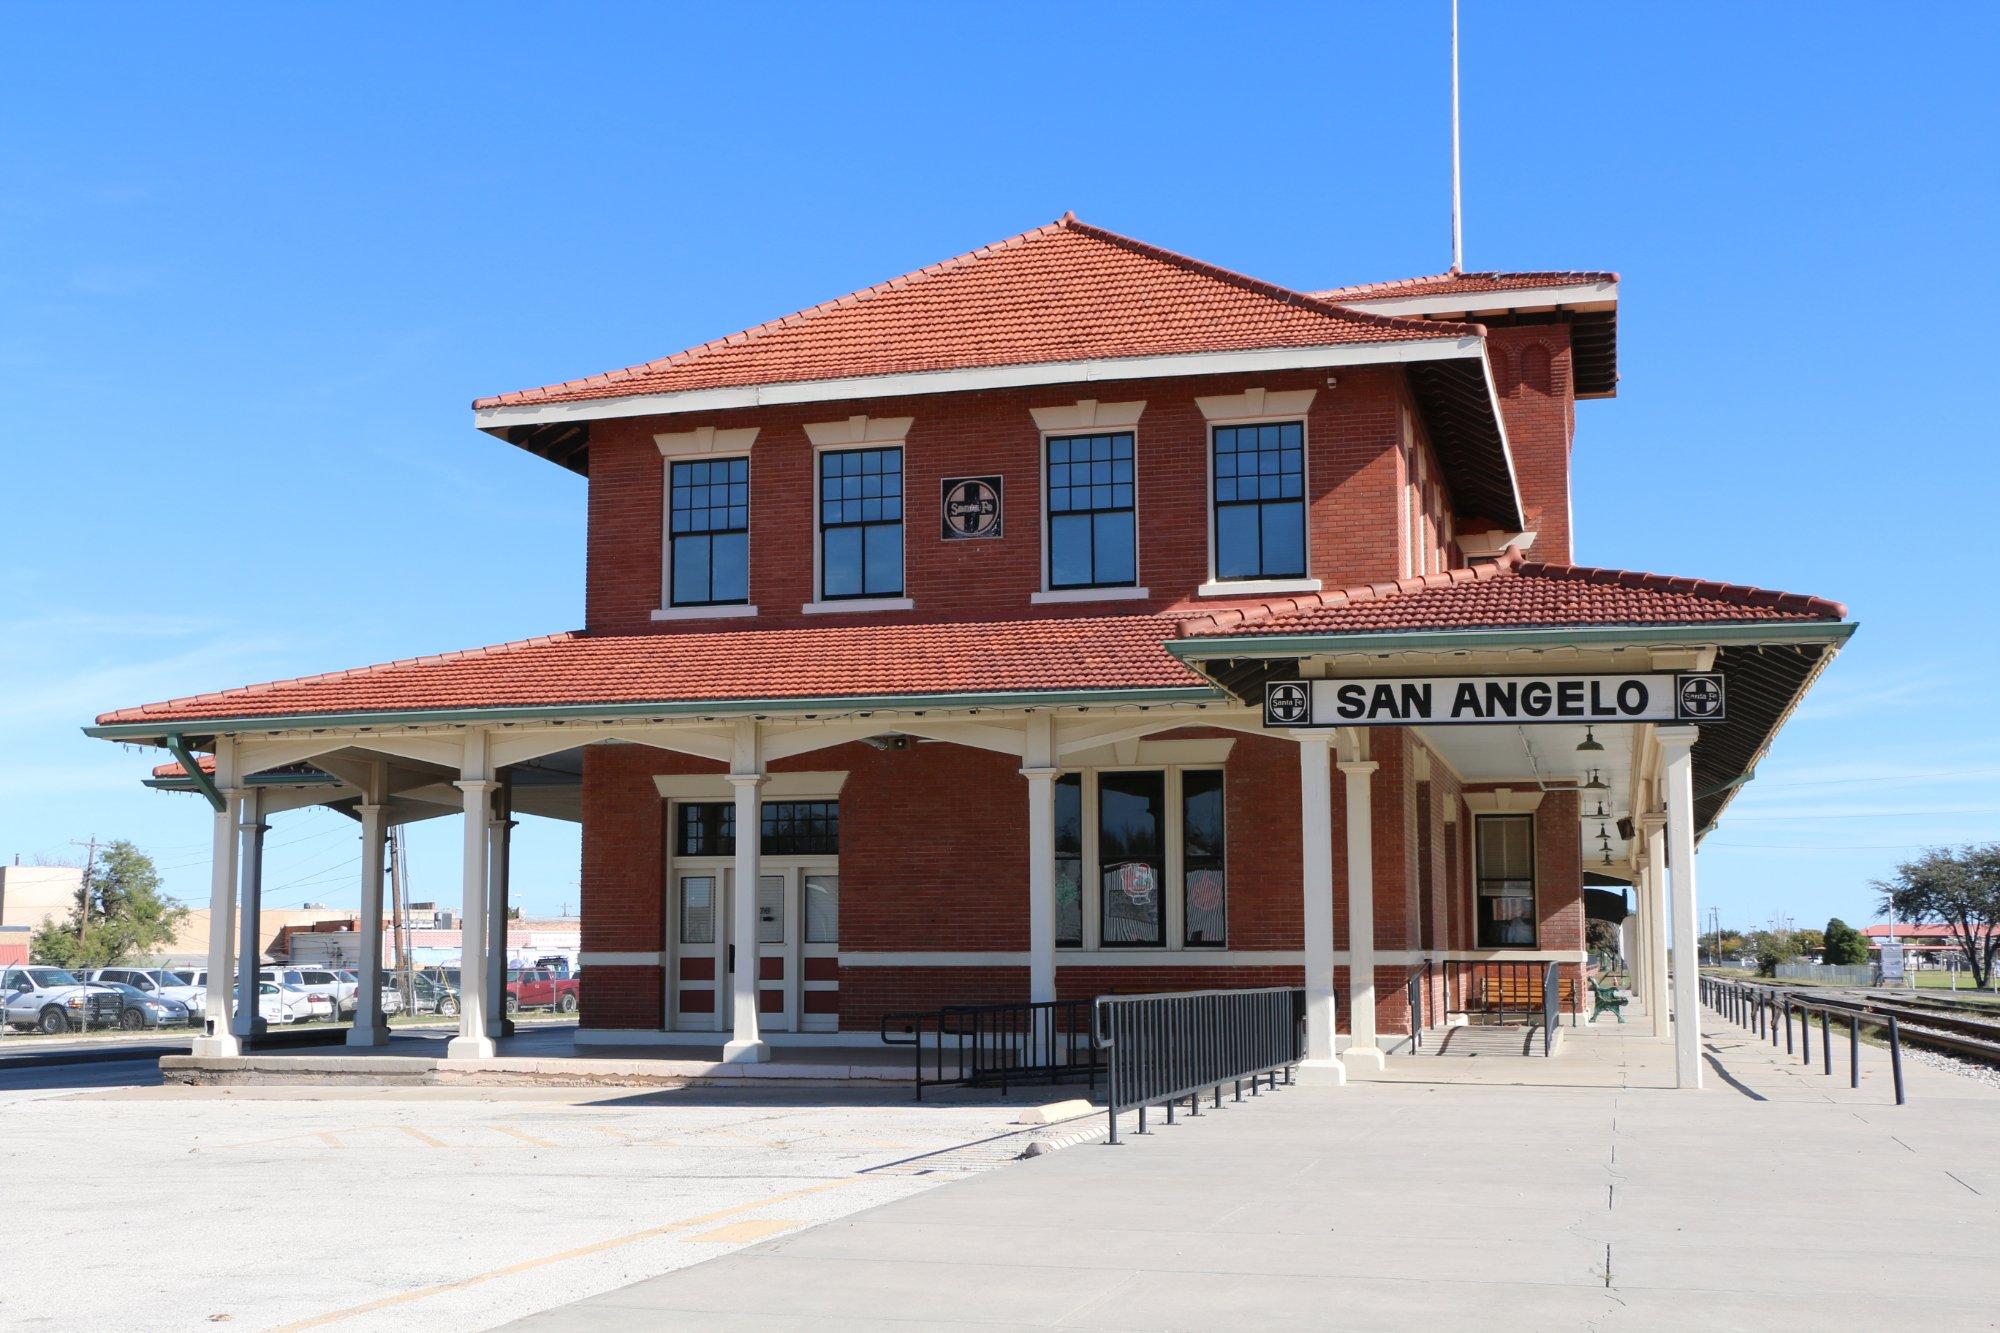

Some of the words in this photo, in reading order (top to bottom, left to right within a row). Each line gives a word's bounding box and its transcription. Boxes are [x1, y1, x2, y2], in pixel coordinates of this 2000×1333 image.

[951, 503, 980, 515] Santa
[1337, 684, 1432, 720] SAN
[1451, 680, 1650, 719] ANGELO
[1684, 692, 1707, 701] Santa
[1708, 692, 1717, 701] Fe
[1272, 699, 1293, 707] Santa
[1294, 698, 1303, 707] Fe
